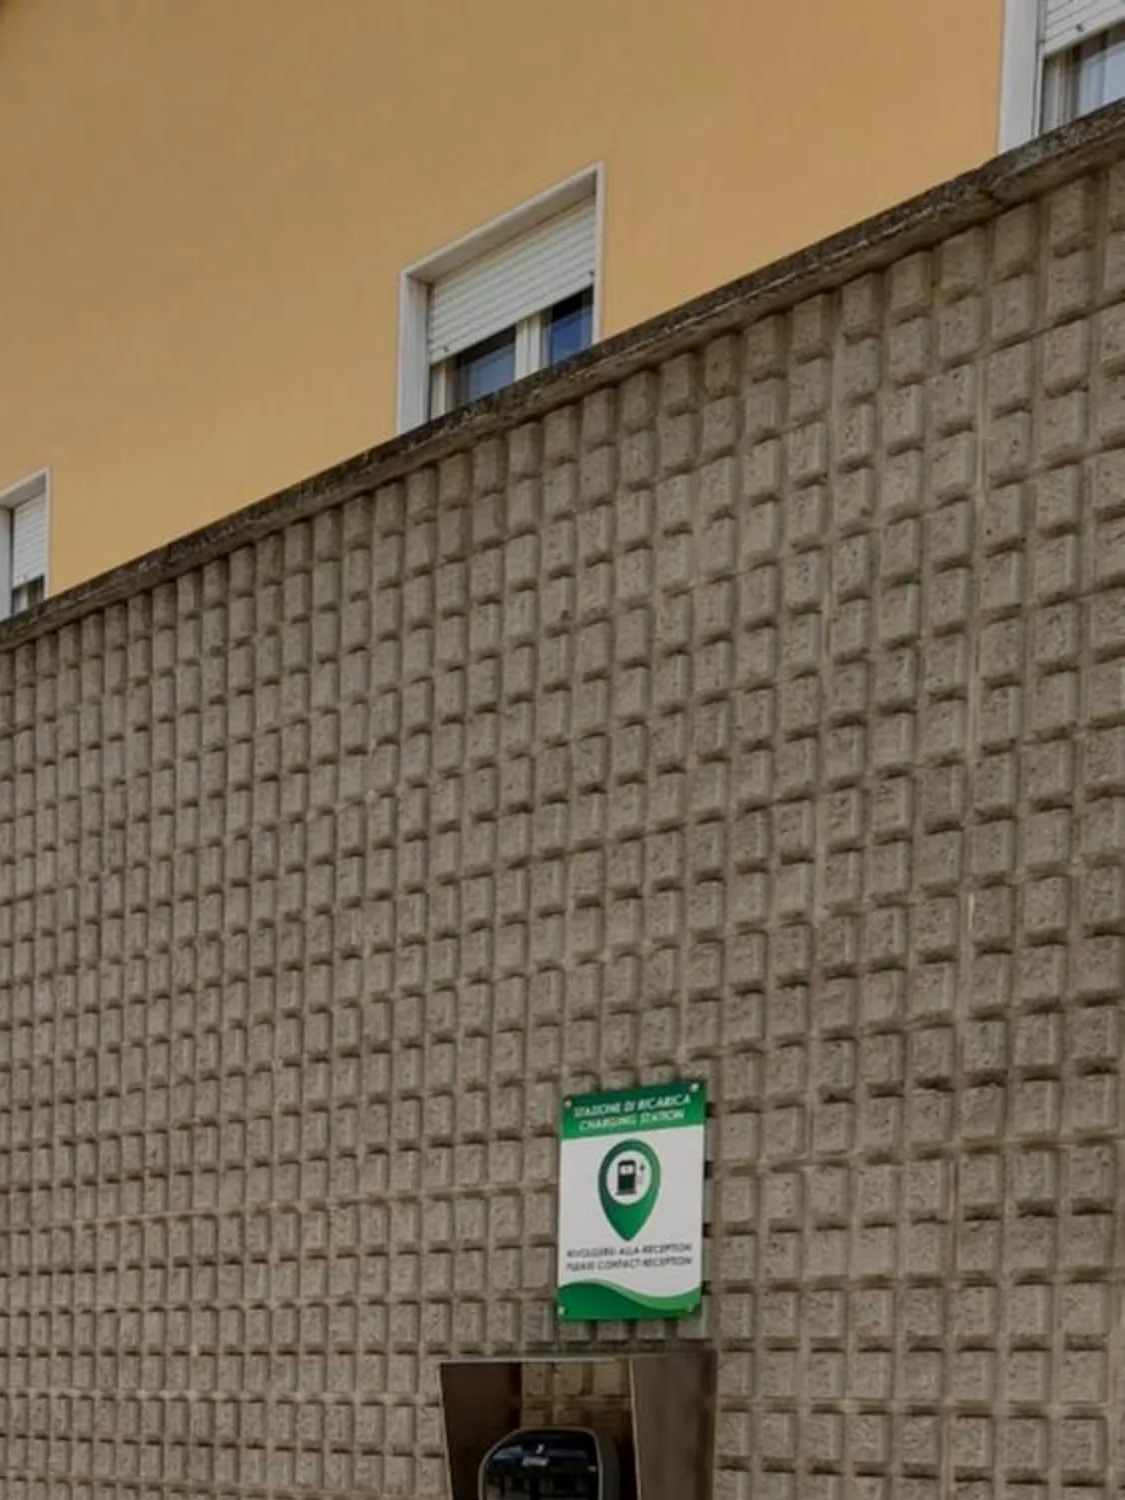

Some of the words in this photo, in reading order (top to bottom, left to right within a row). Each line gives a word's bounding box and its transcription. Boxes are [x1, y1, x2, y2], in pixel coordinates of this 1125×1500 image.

[574, 1103, 621, 1117] STAZIONE
[624, 1101, 635, 1111] DI
[638, 1094, 691, 1110] RICARICA
[579, 1114, 637, 1130] CHARGING
[639, 1109, 685, 1124] STATION
[643, 1242, 692, 1253] RECEPTION
[598, 1258, 641, 1270] CONTACT
[643, 1256, 692, 1267] RECEPTION
